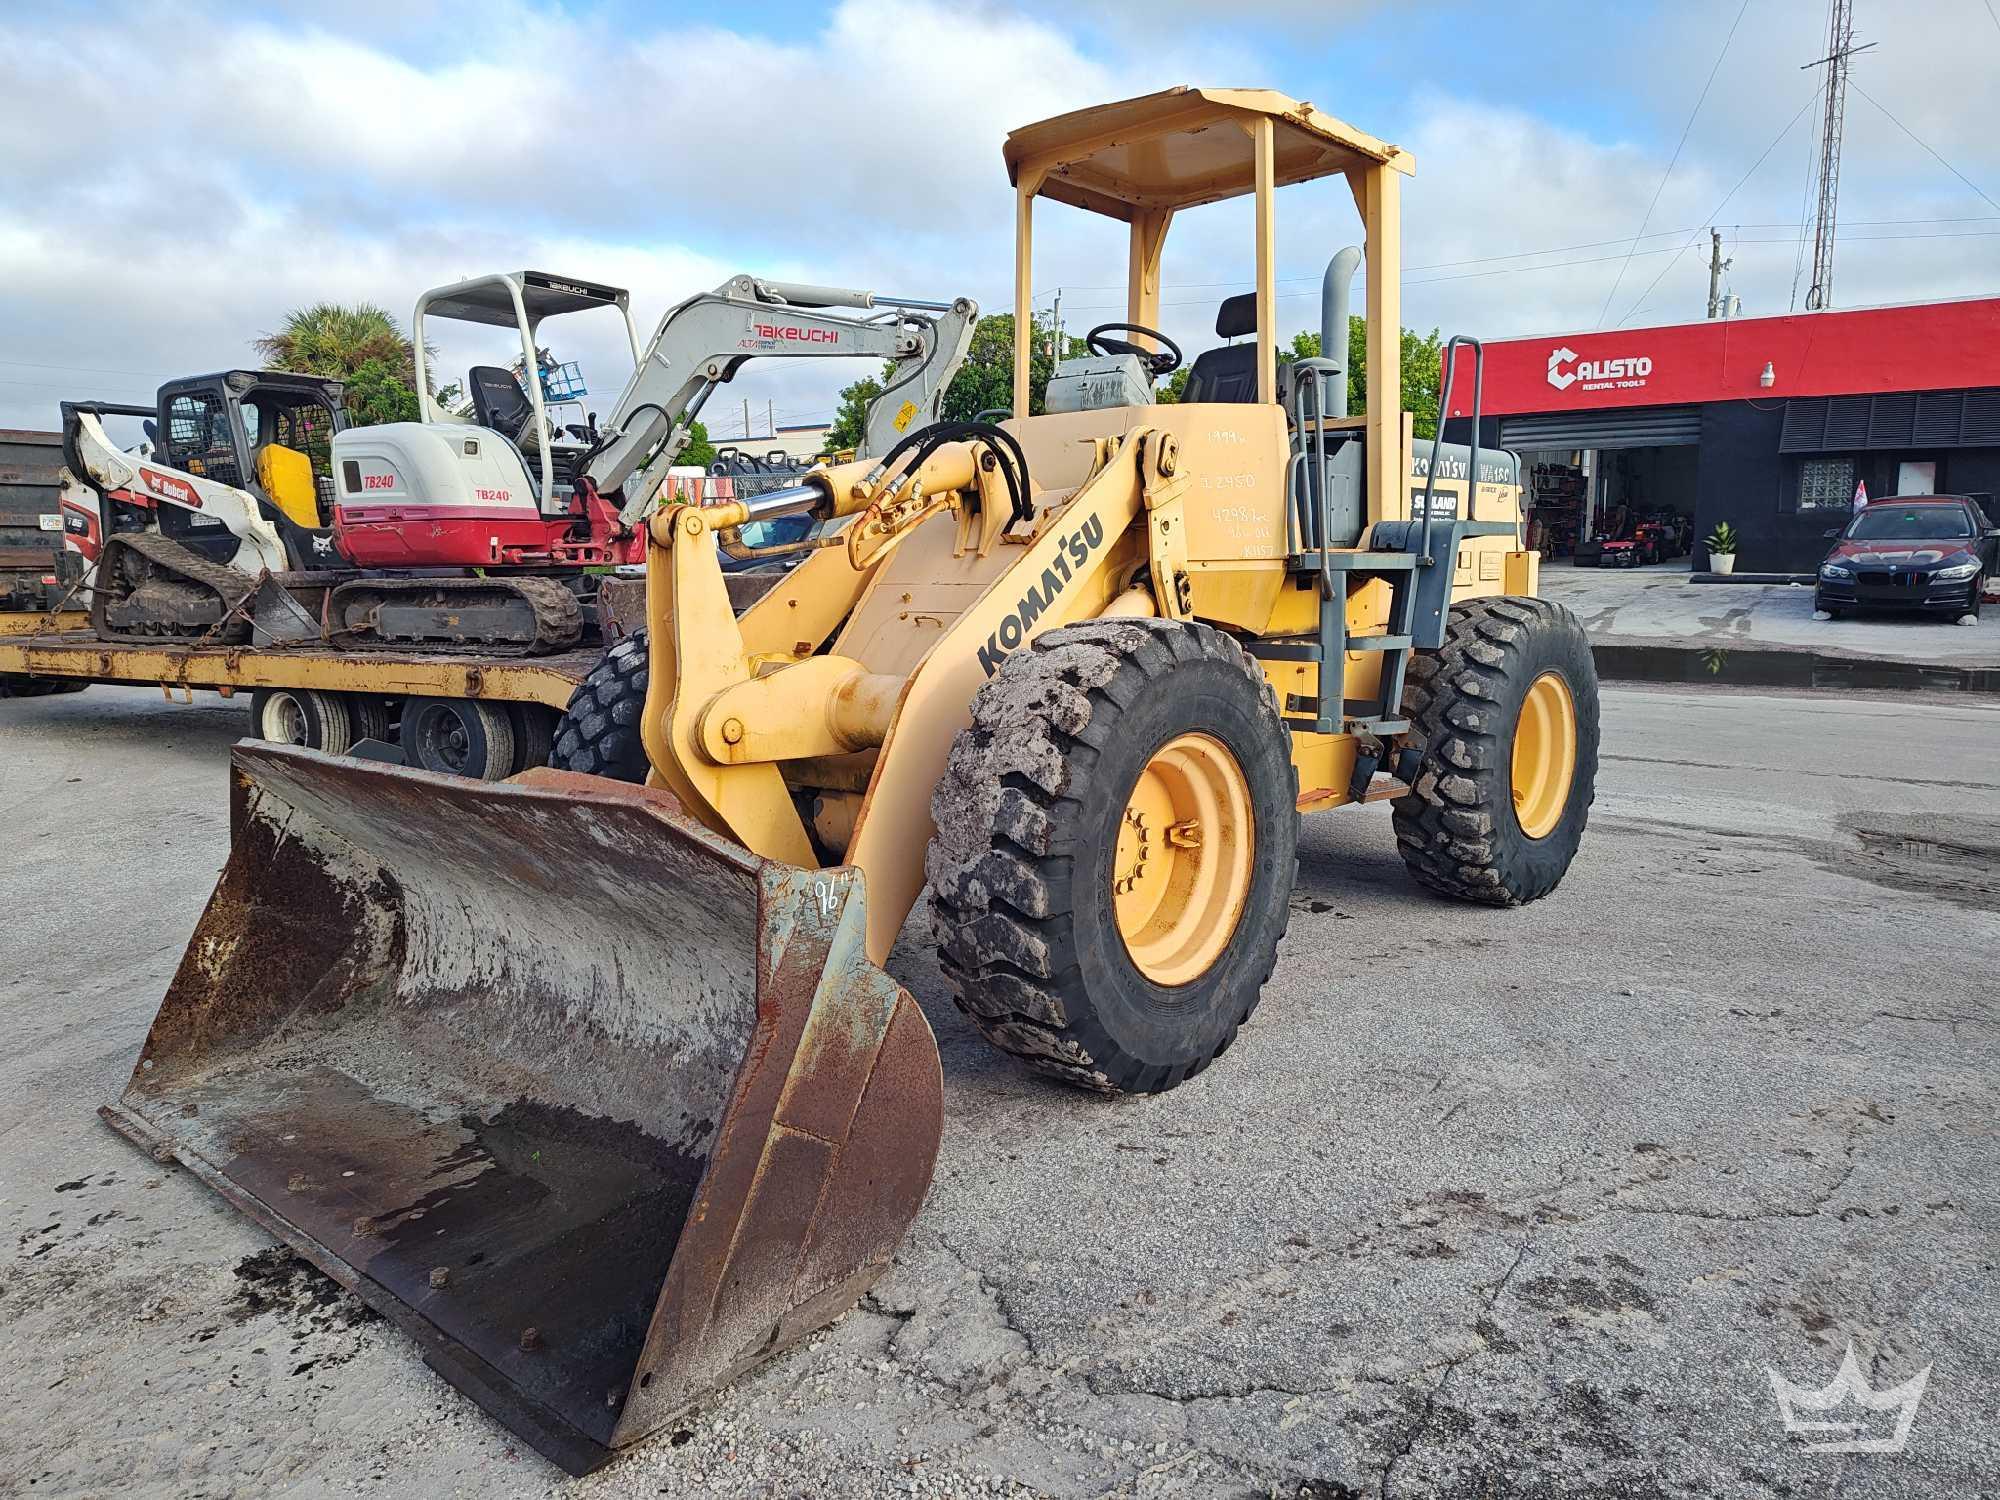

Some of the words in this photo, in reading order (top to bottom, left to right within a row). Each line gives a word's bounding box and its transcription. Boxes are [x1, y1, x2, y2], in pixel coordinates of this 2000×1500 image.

[547, 281, 588, 295] TAKEUCHI
[753, 324, 839, 343] TAKEUCHI
[1582, 382, 1615, 391] RENTAL
[1616, 379, 1647, 388] TOOLS
[1411, 456, 1467, 479] KOATSU
[364, 475, 394, 488] TB240
[163, 481, 189, 501] Bobcat
[475, 490, 509, 501] TB240
[977, 512, 1104, 679] KOMATSU
